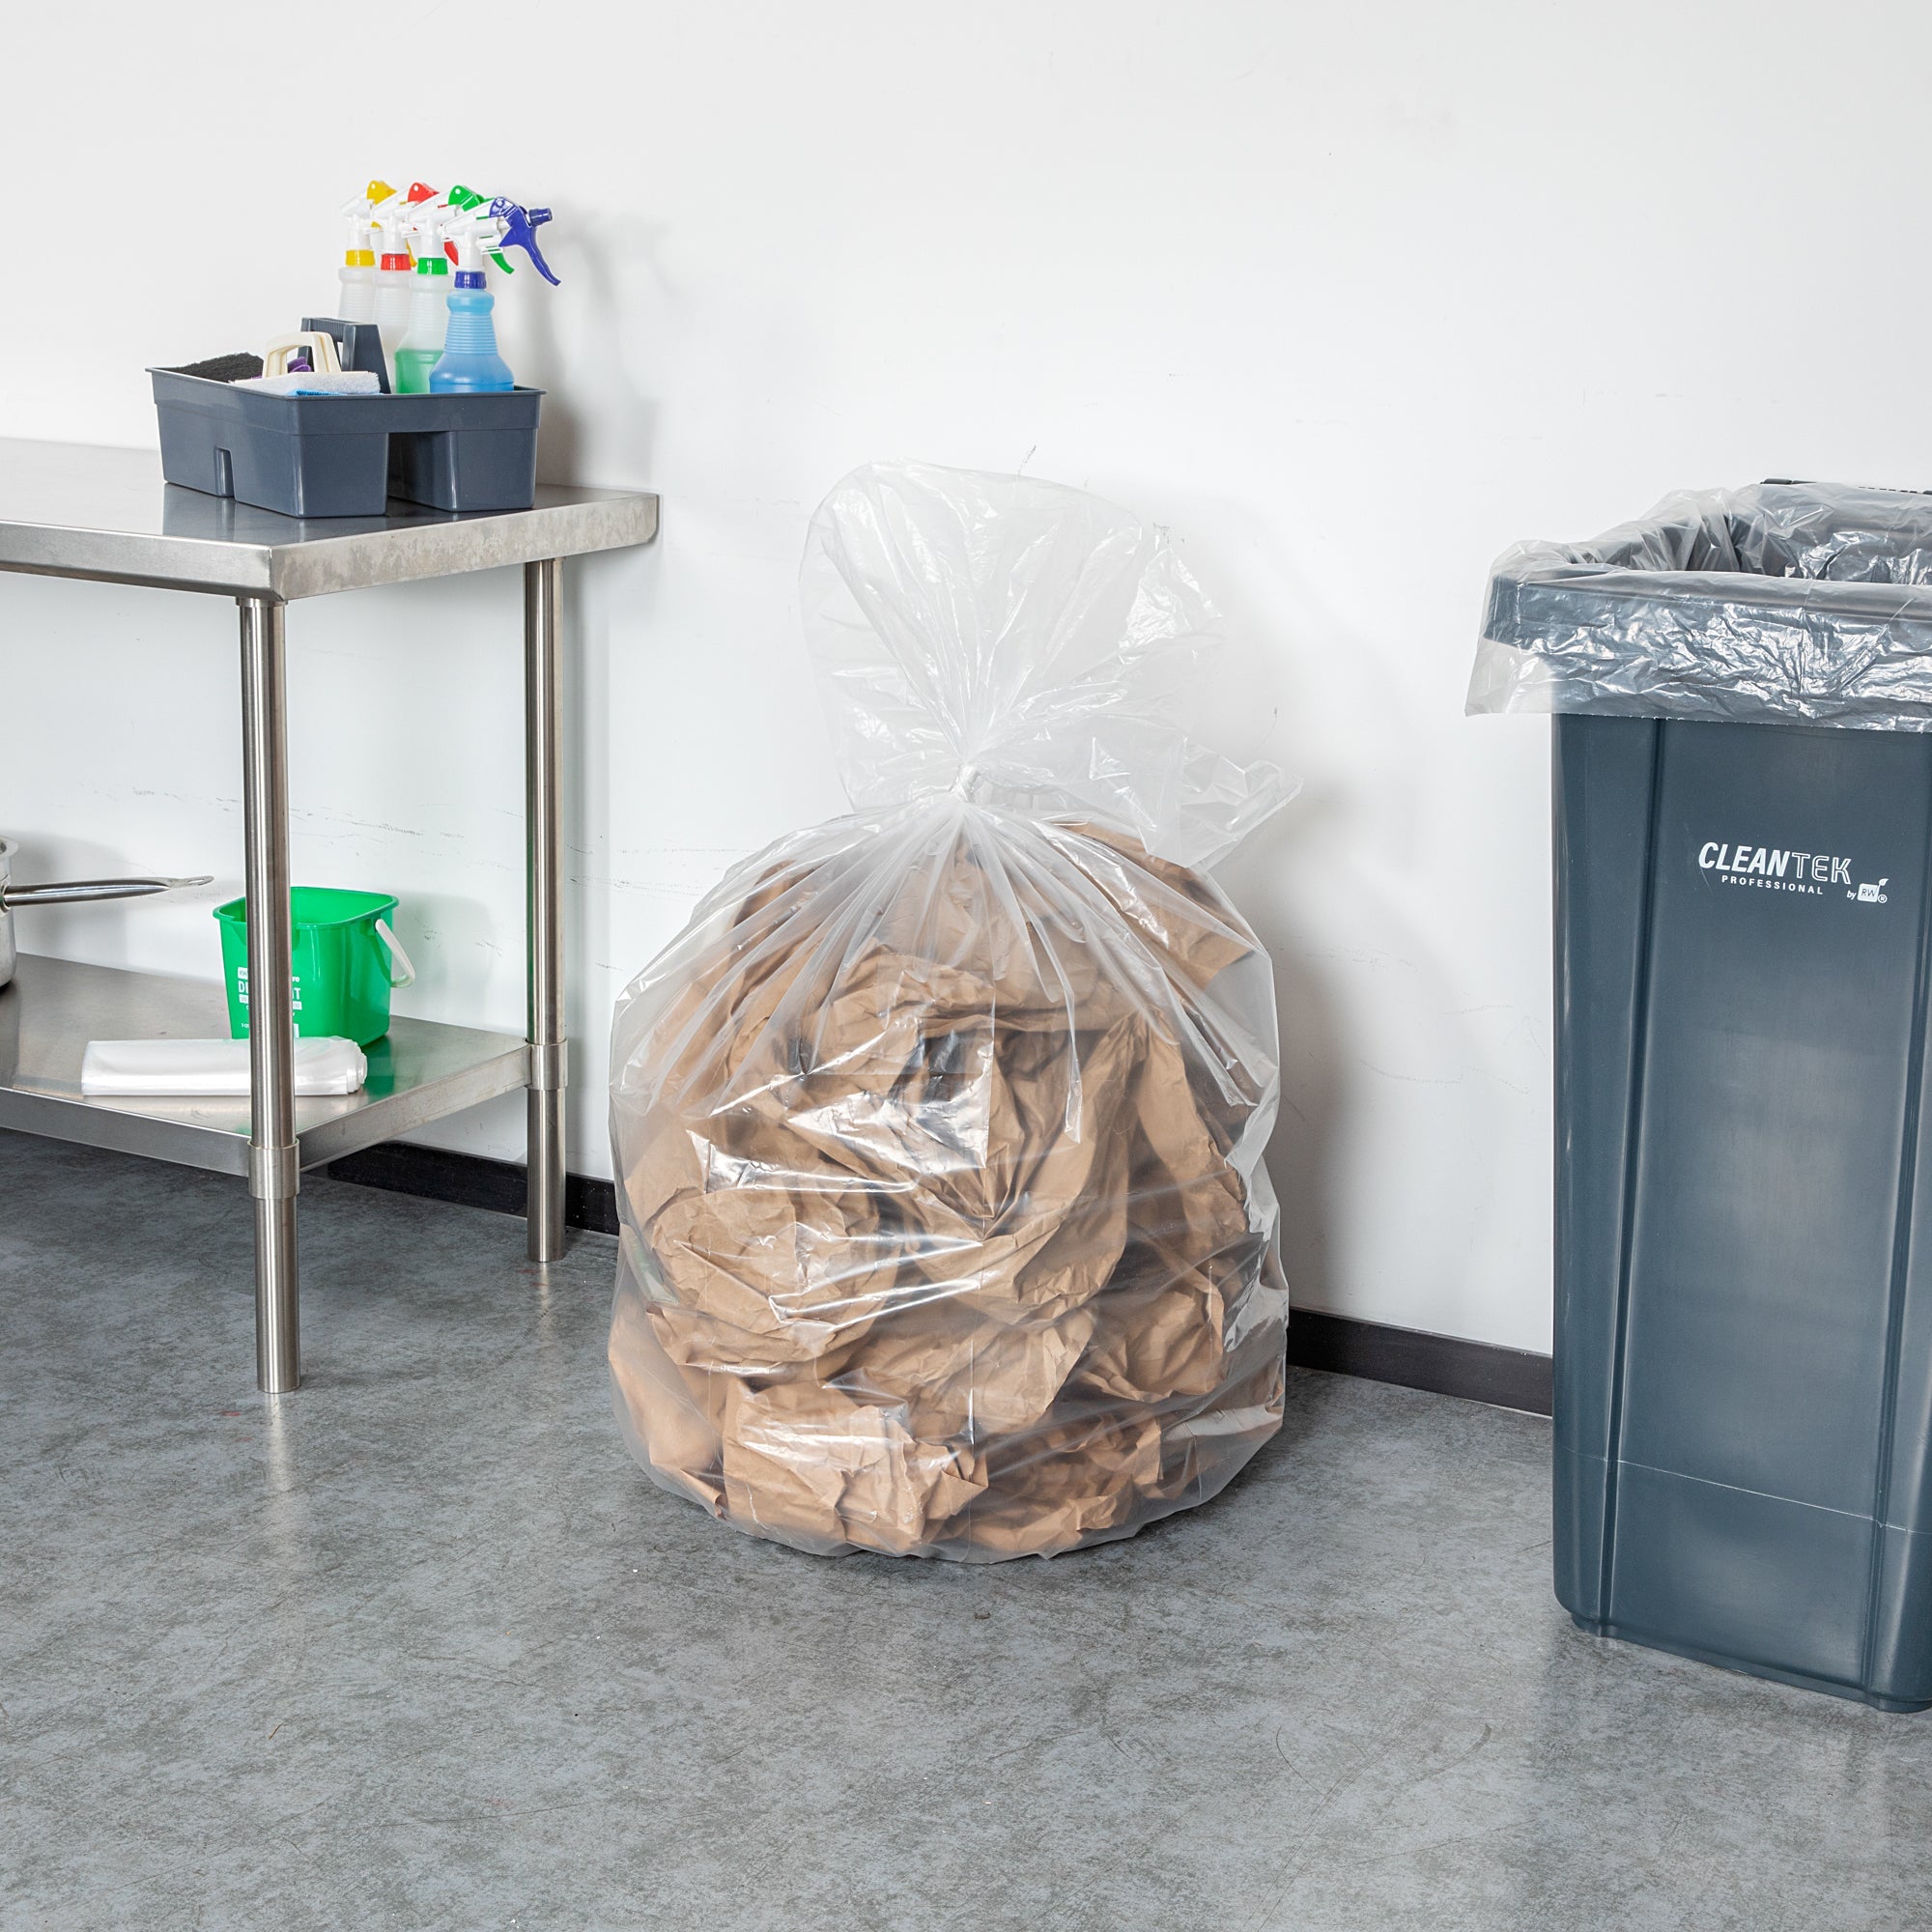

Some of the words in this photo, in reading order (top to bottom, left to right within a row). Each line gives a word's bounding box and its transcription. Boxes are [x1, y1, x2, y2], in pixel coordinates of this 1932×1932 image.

[1698, 841, 1852, 885] CLEANTEK
[1721, 874, 1824, 895] PROFESSIONAL
[1846, 890, 1857, 900] by
